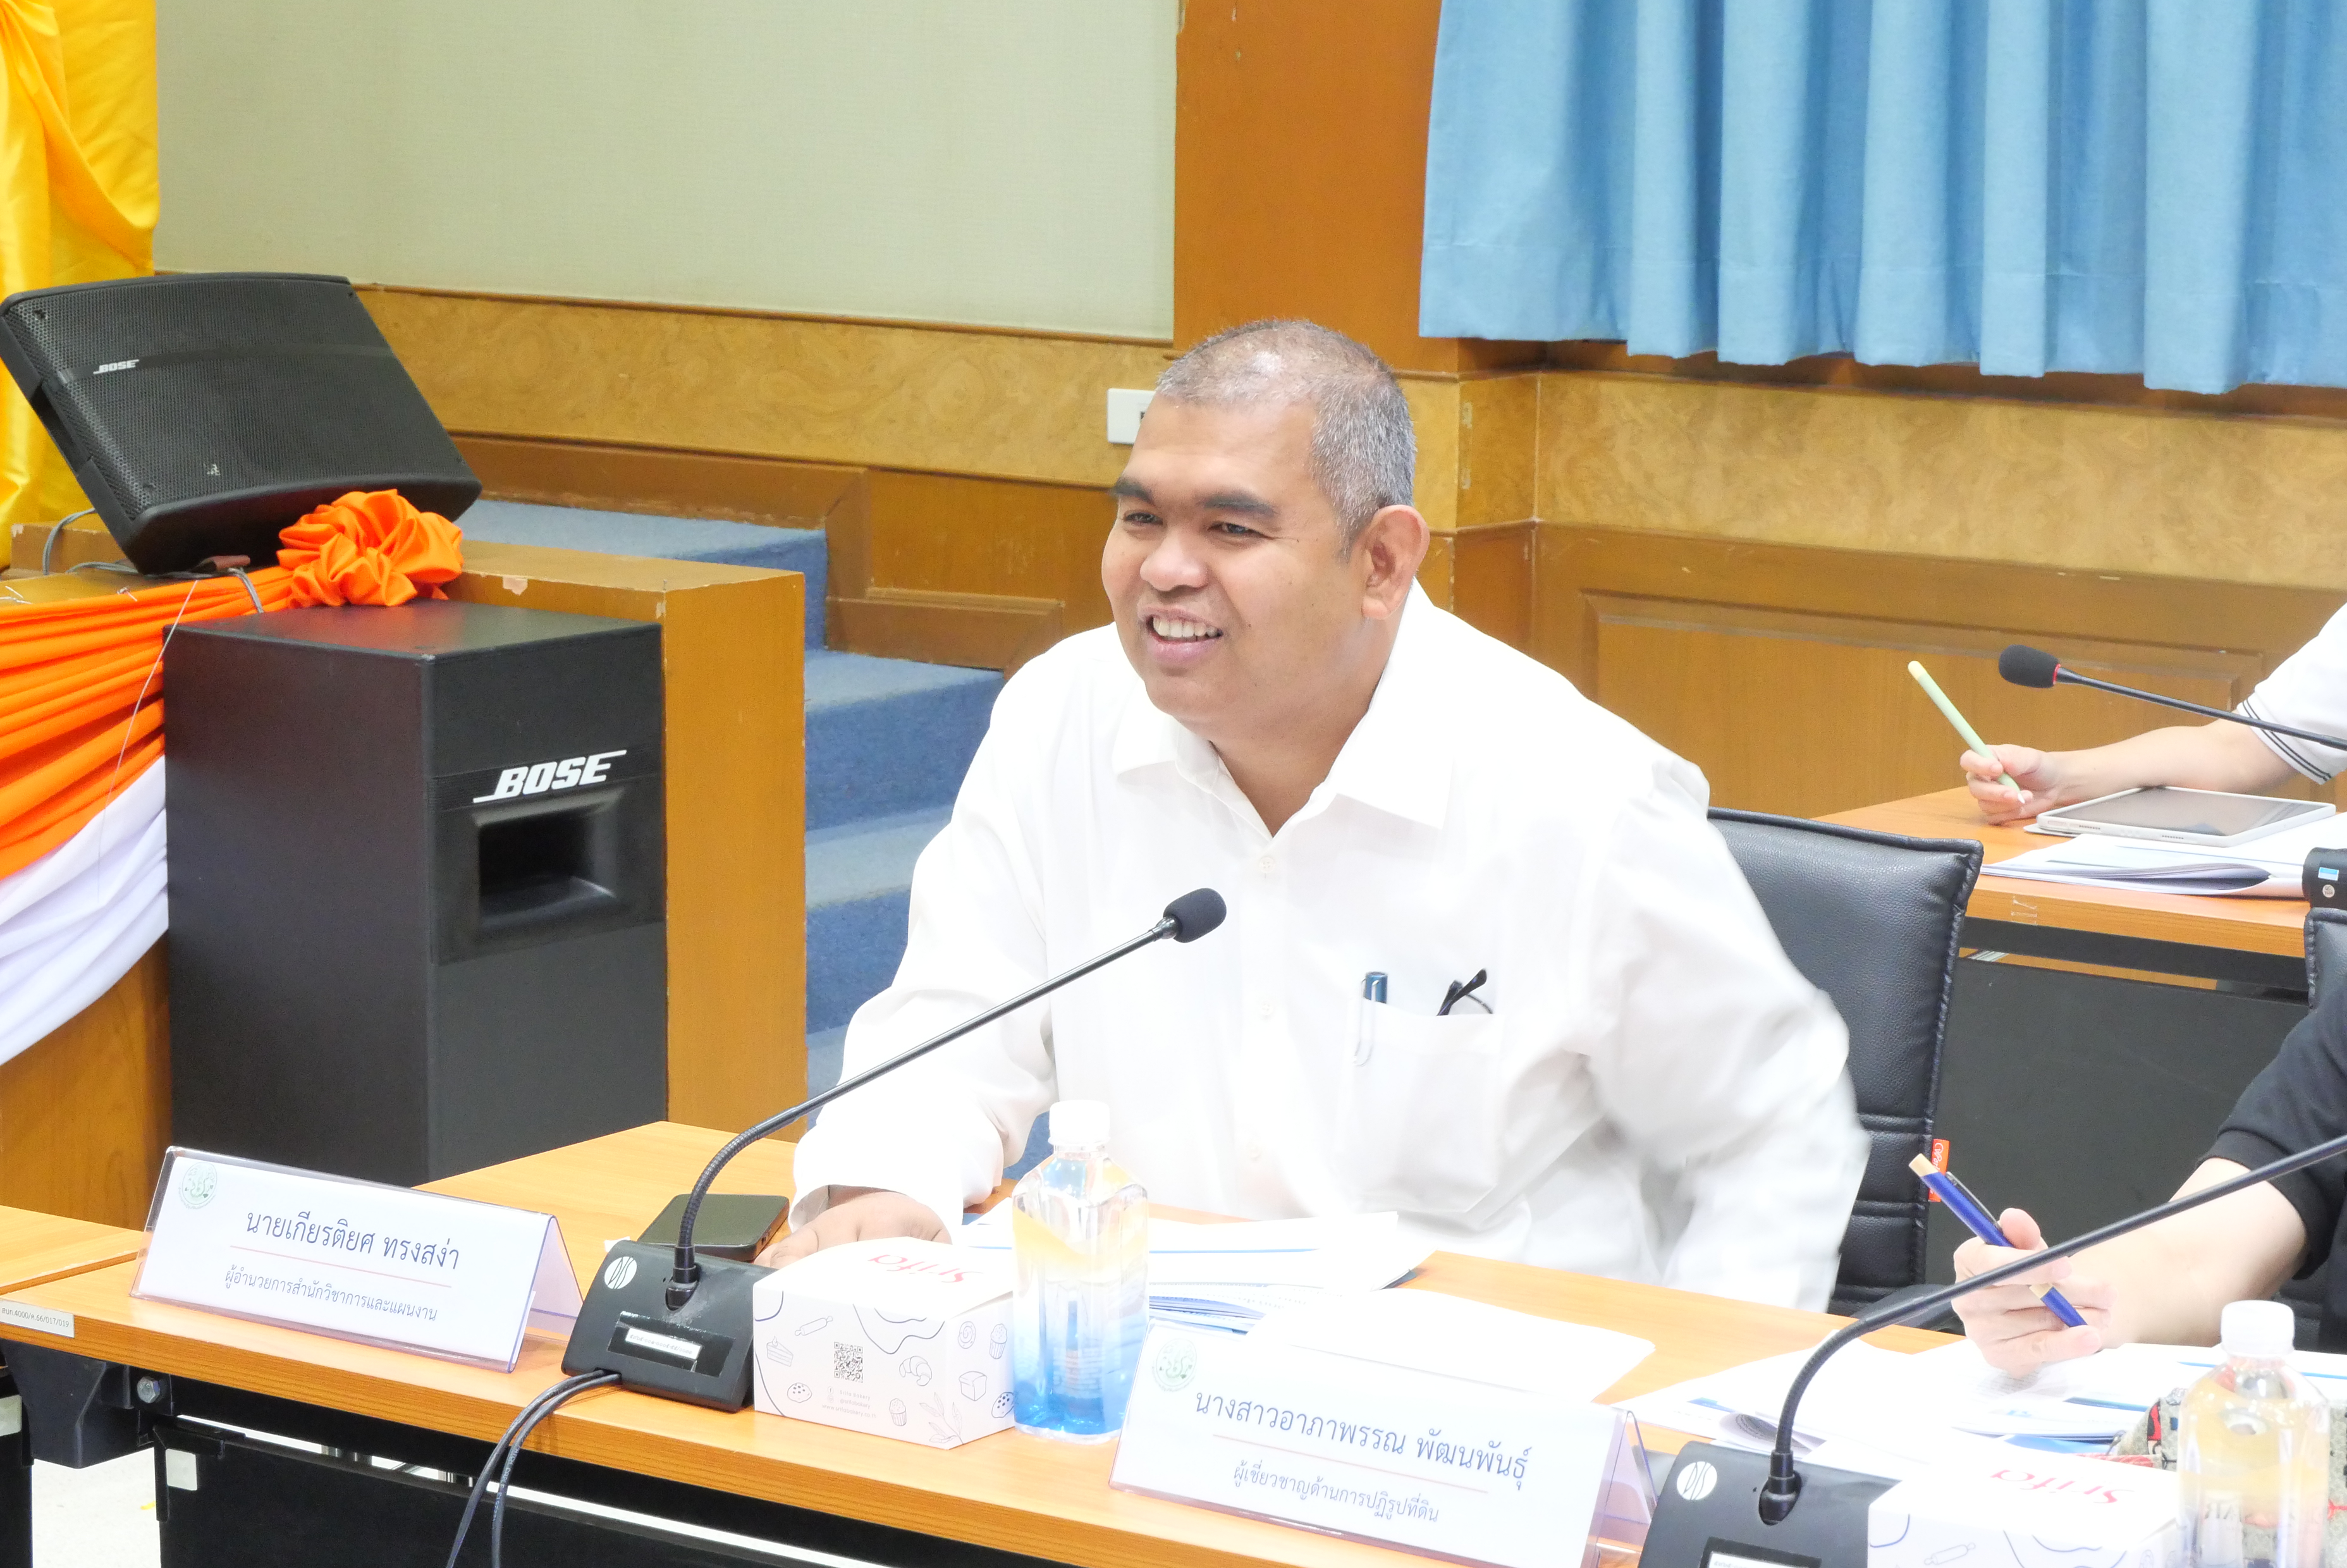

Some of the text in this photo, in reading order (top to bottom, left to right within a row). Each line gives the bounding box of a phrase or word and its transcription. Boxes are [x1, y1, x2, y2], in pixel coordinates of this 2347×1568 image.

[93, 358, 140, 374] BOSE
[472, 749, 627, 804] BOSE
[246, 1210, 460, 1270] นายเกียรติยศ ทรงสง่า
[224, 1264, 438, 1322] ผู้อำนวยการสำนักวิชาการและแผนงาน
[868, 1254, 984, 1283] Srifa
[1195, 1390, 1532, 1490] นางสาวอาภาพรรณ พัฒนพันธุ์
[1233, 1458, 1440, 1523] ผู้เชี่ยวชาญด้านการปฏิรูปที่ดิน
[1990, 1469, 2135, 1504] Srifa
